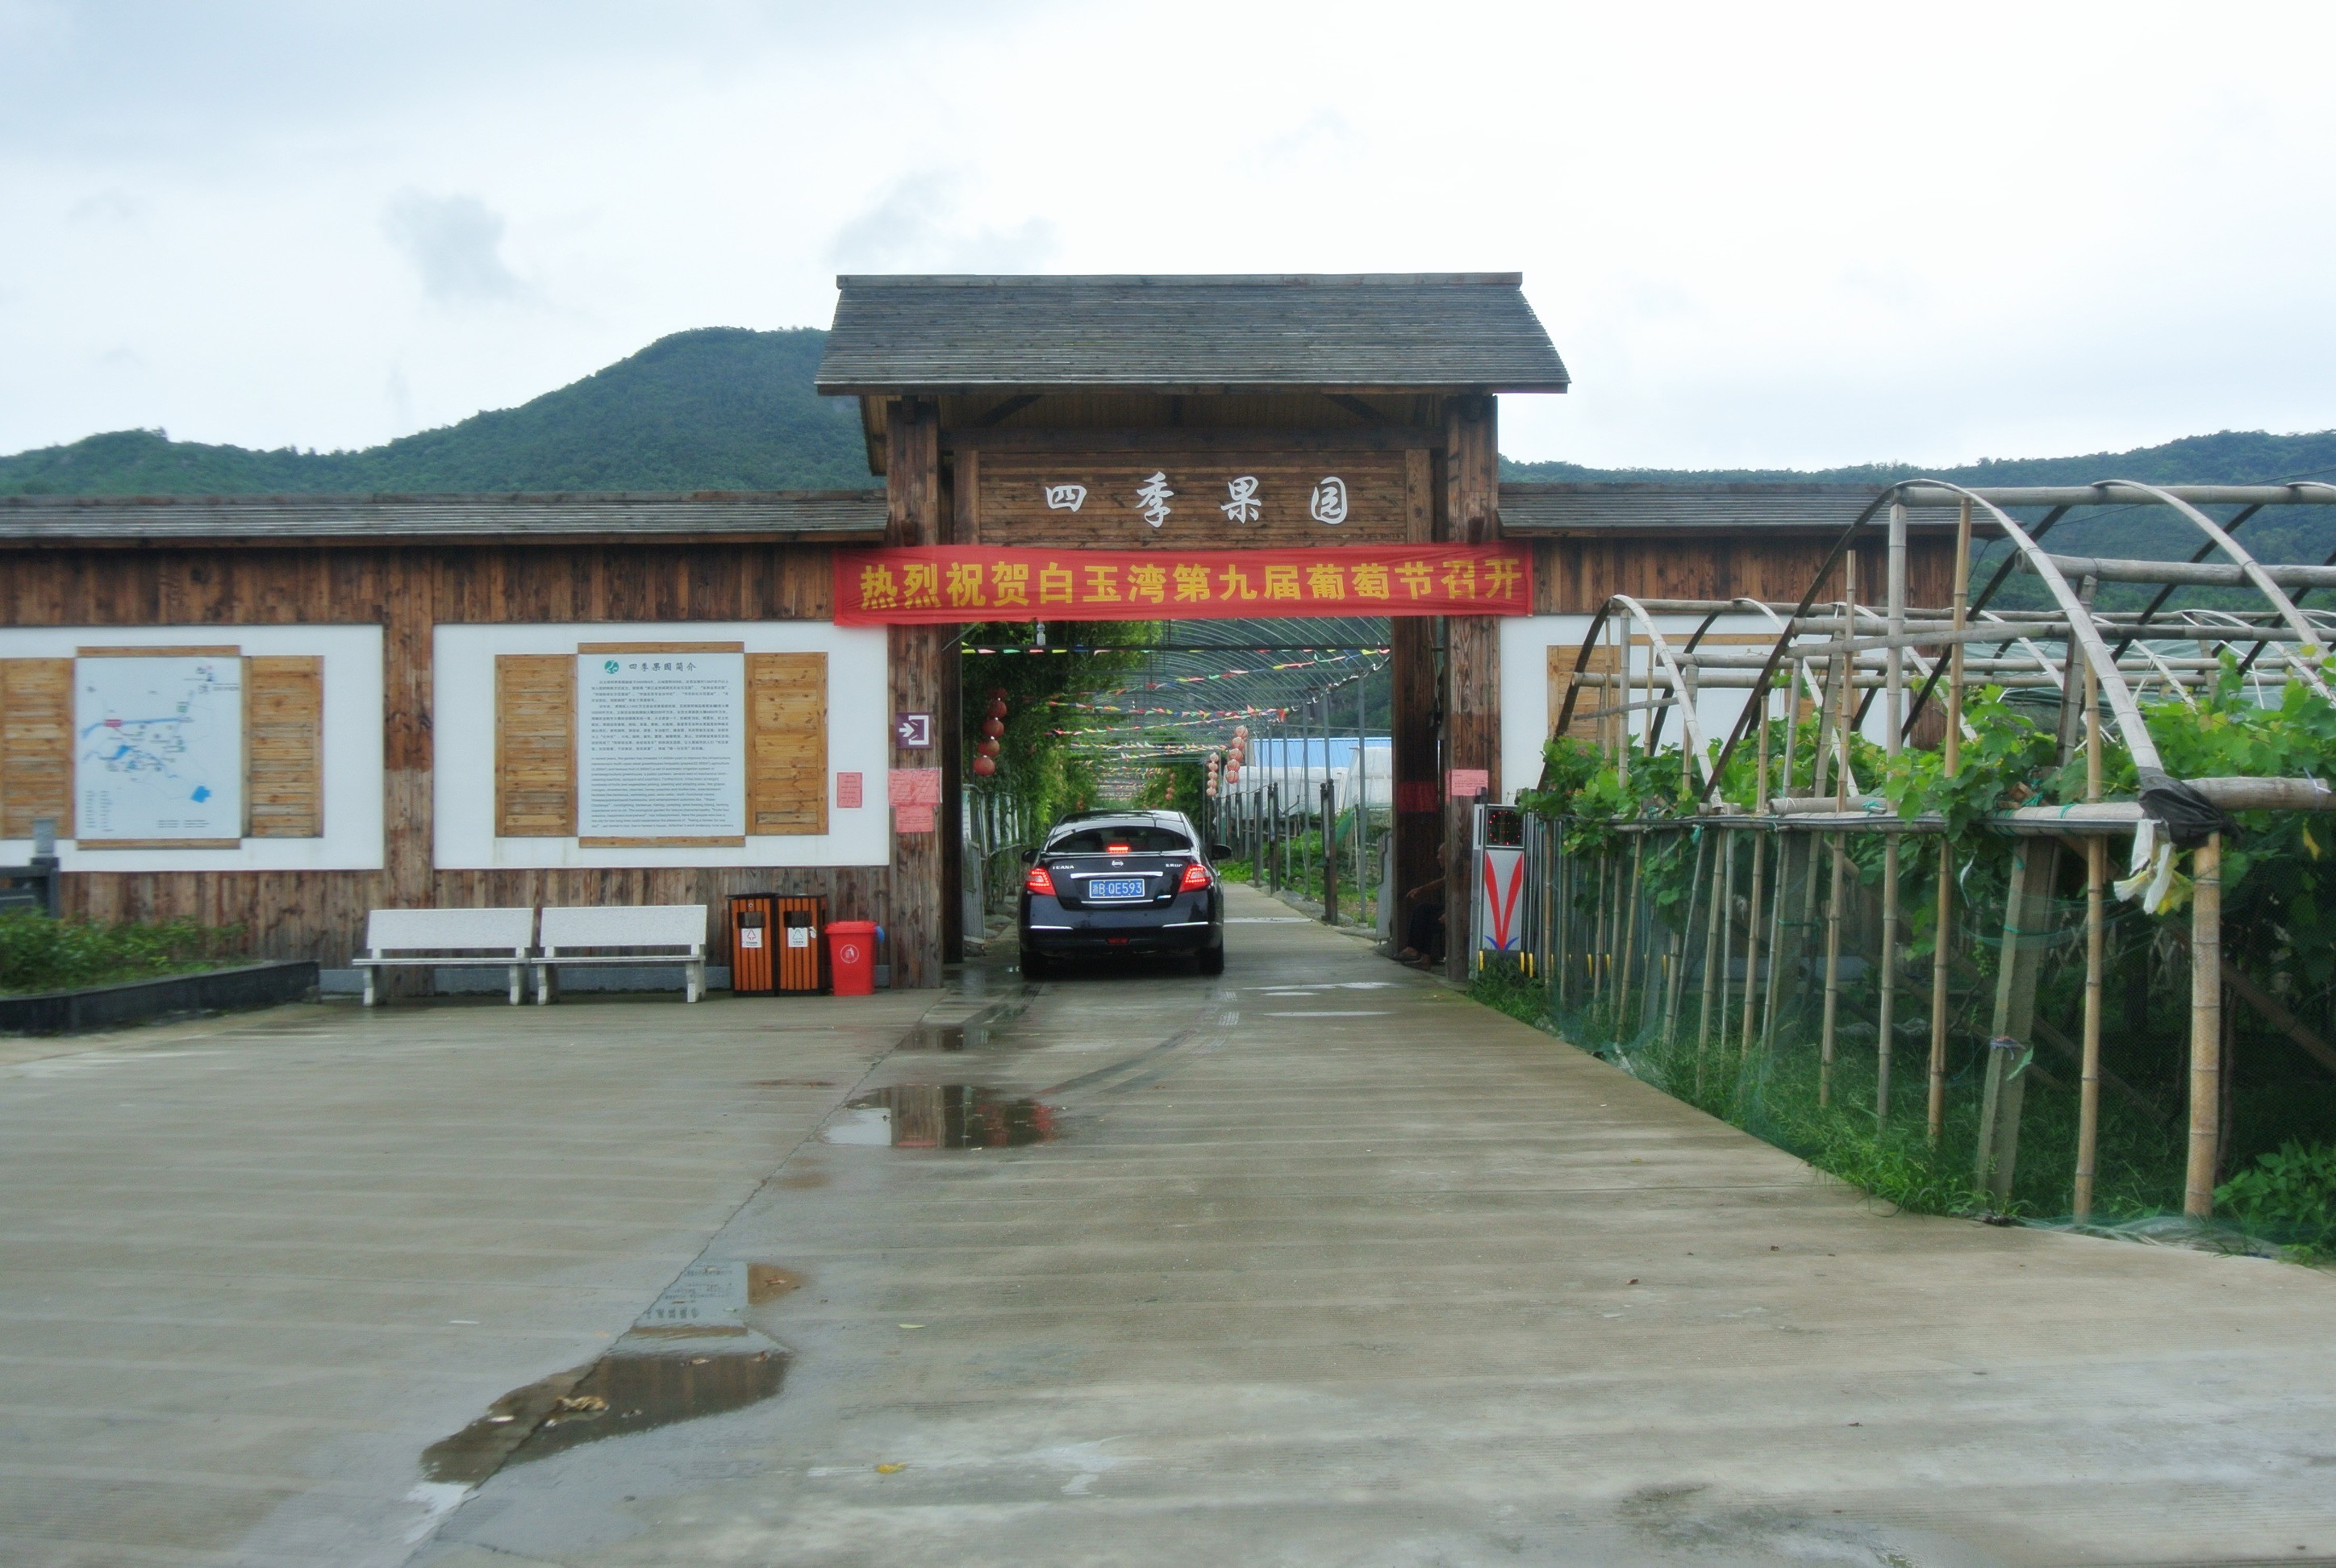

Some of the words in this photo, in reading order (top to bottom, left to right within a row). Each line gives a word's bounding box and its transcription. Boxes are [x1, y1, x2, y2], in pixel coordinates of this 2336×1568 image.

[1045, 471, 1348, 528] 四季果园
[860, 558, 1522, 610] 热烈祝贺白玉湾第九届葡萄节召开
